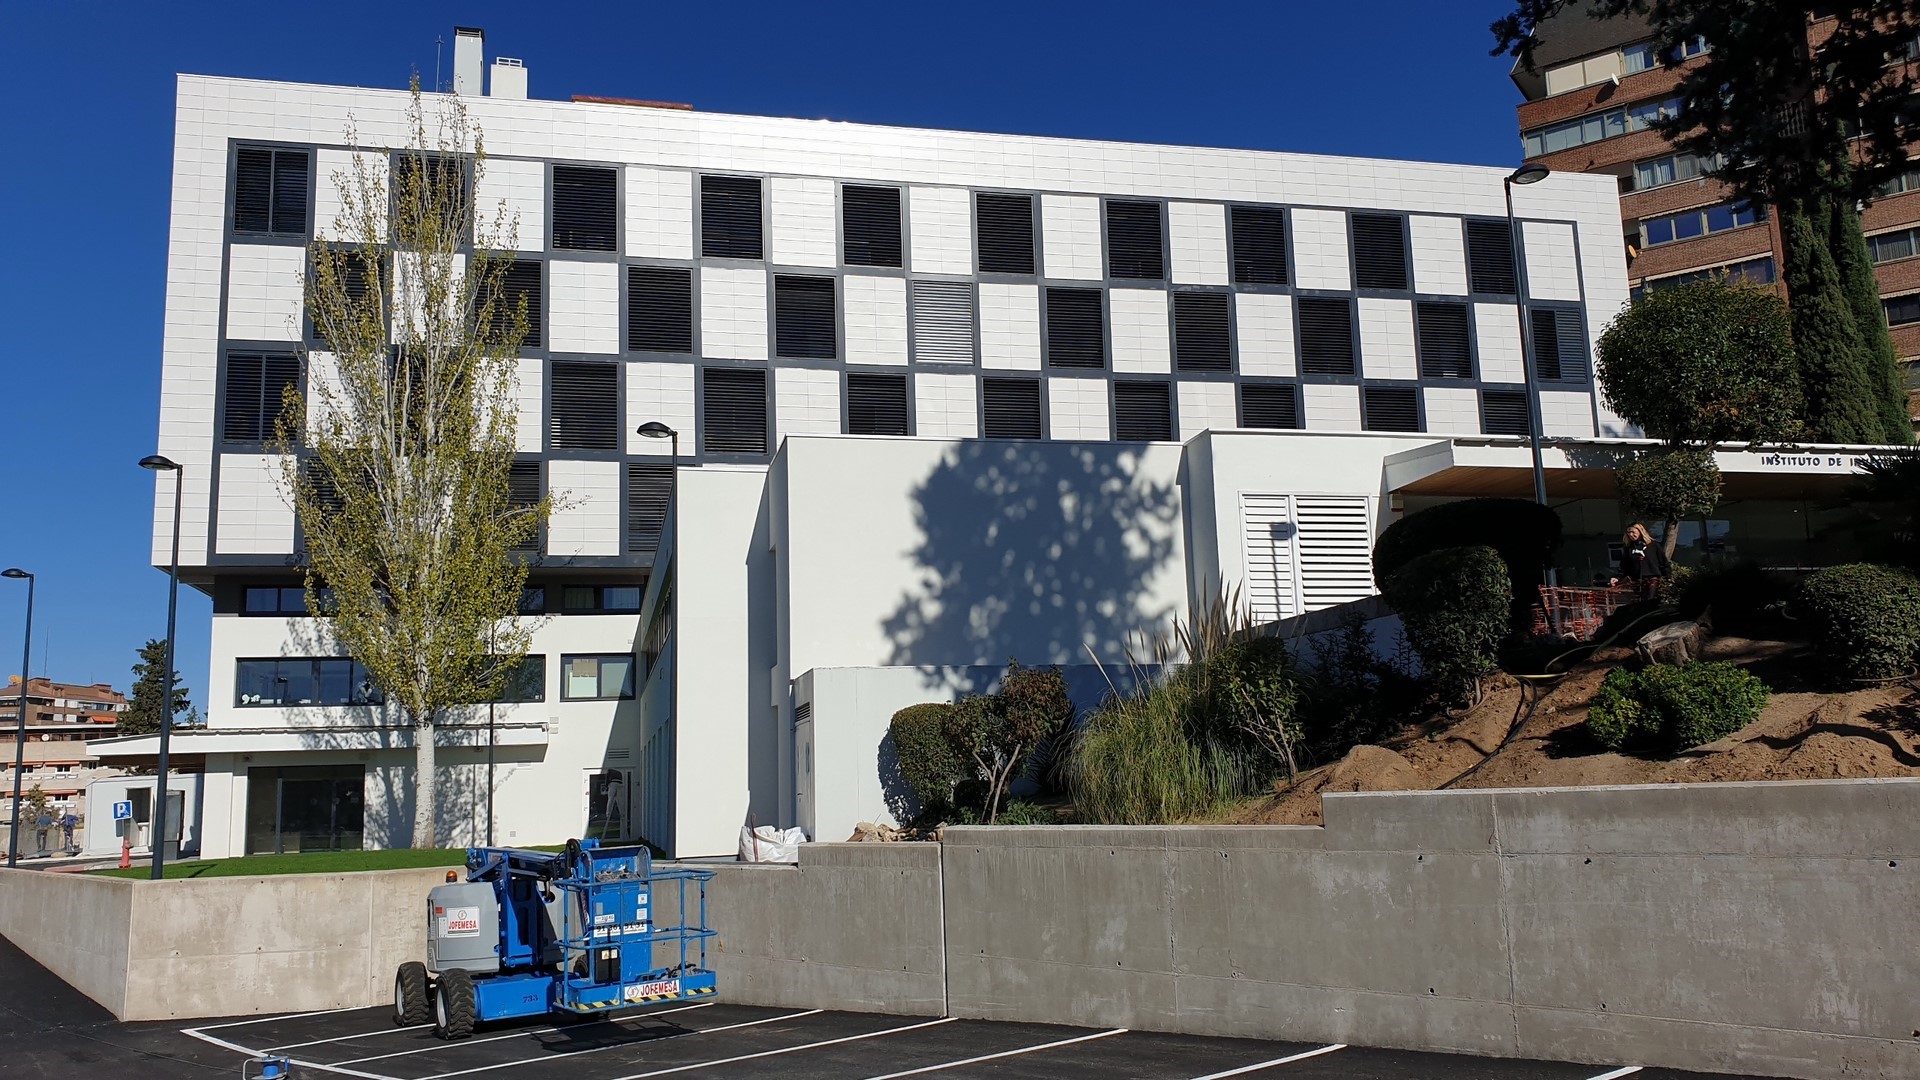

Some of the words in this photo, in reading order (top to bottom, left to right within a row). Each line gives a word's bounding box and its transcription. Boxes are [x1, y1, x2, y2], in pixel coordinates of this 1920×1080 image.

[1761, 456, 1821, 467] INSTITUTO
[1828, 457, 1842, 467] DE
[117, 803, 126, 818] P
[449, 920, 477, 930] JOFEMESA
[640, 980, 678, 996] JOFEMESA
